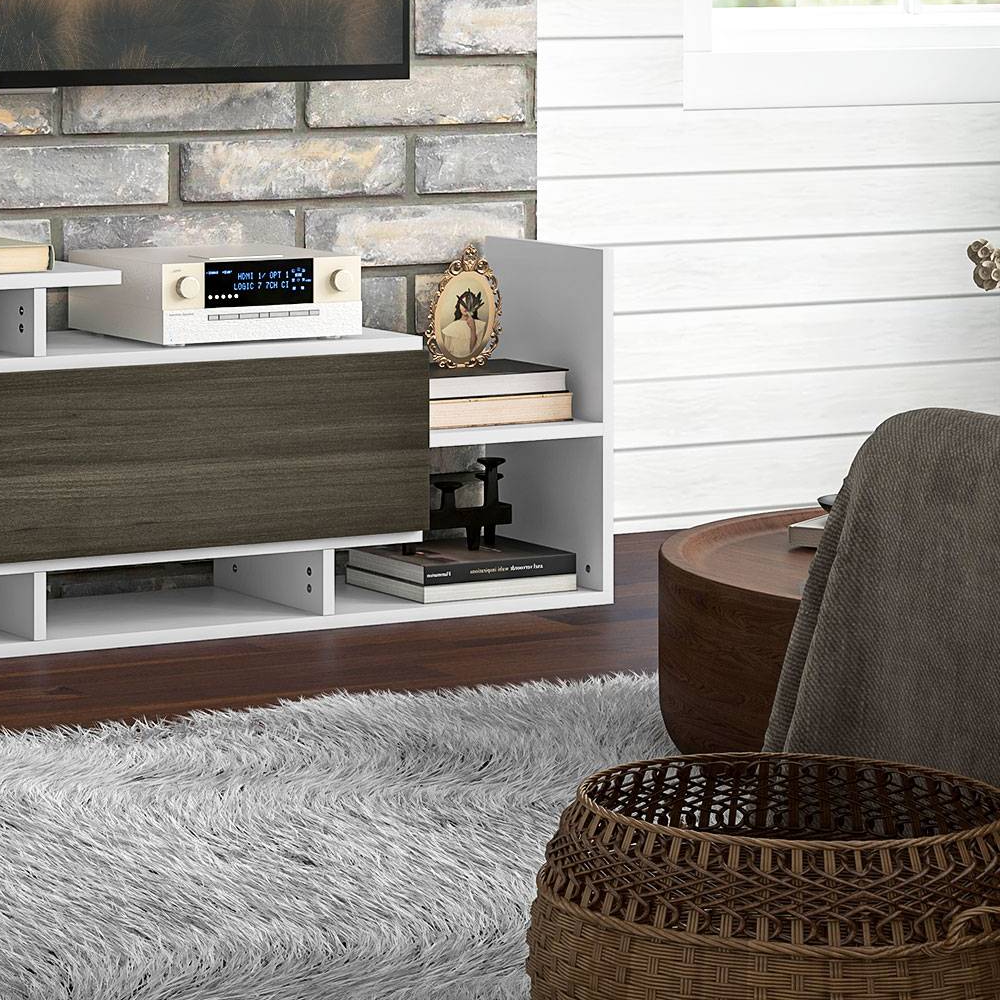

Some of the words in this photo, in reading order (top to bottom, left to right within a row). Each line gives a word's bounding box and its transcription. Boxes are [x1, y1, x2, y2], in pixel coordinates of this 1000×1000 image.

[237, 271, 254, 281] HDMI
[269, 270, 282, 279] OPT
[233, 282, 255, 291] LOGIC
